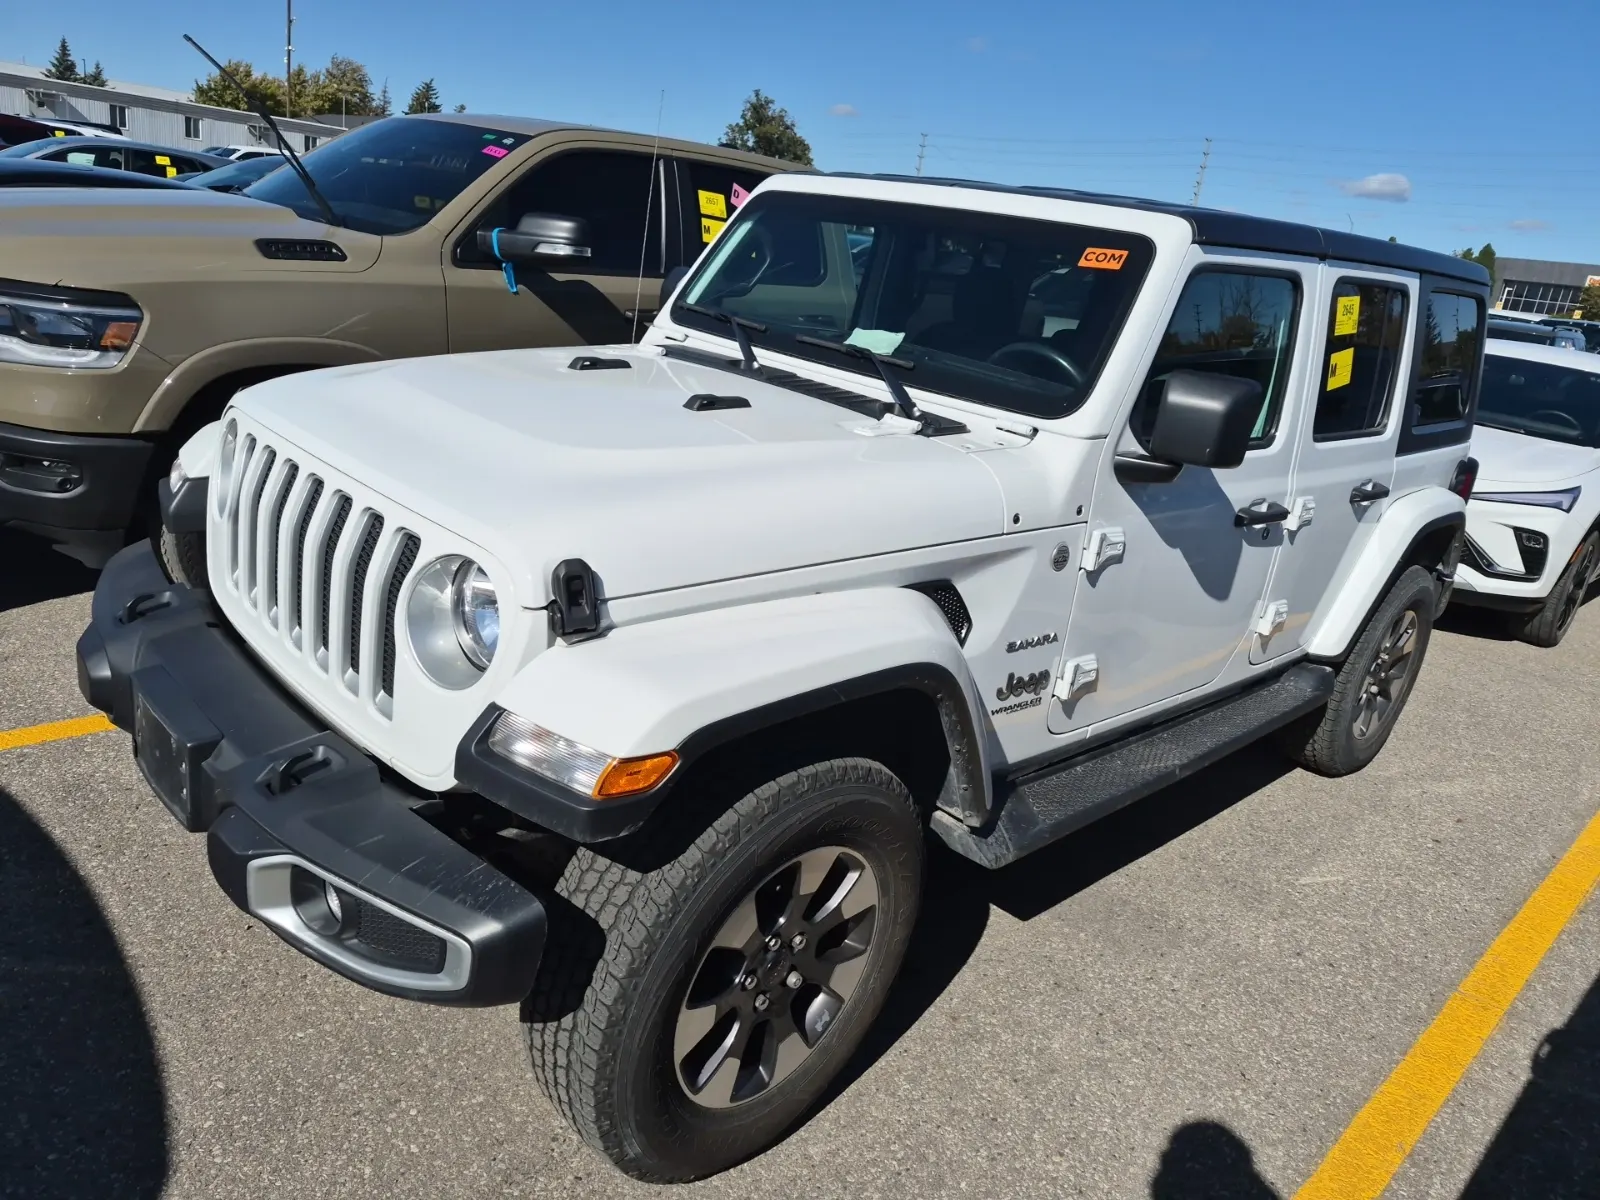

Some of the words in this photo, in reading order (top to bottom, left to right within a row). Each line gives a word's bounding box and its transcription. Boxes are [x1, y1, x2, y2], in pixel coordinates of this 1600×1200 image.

[733, 189, 740, 199] D
[703, 224, 711, 236] M
[1084, 251, 1124, 265] COM
[1342, 303, 1355, 317] 2645
[1329, 362, 1338, 379] M
[1005, 632, 1059, 654] SAHARA
[996, 669, 1051, 702] Jeep
[990, 696, 1043, 716] WRANGLER
